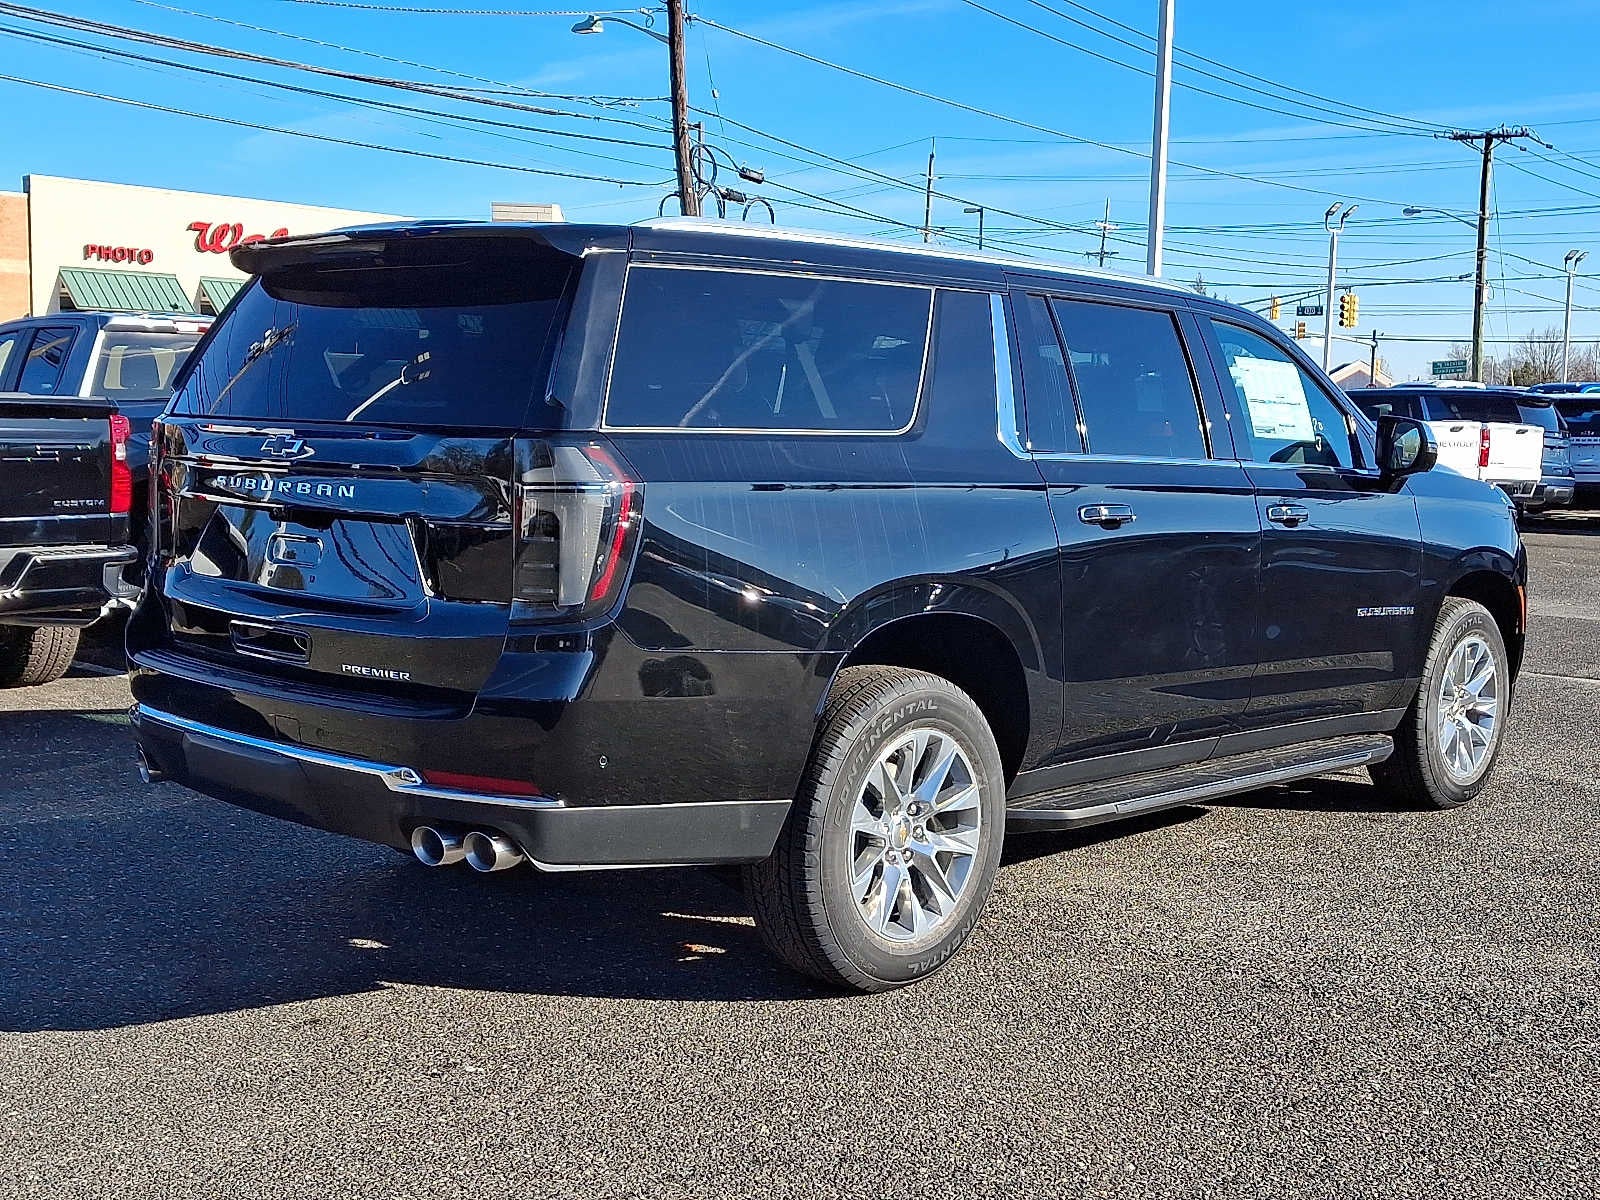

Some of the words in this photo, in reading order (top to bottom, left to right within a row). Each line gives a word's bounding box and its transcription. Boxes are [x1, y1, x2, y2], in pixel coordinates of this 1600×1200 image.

[83, 244, 154, 265] PHOTO
[214, 475, 356, 498] SUBURBAN
[53, 499, 105, 507] CUSTOM
[1357, 606, 1415, 617] SUBURBAN
[341, 663, 411, 681] PREMIER
[833, 699, 939, 828] CONTINENTAL
